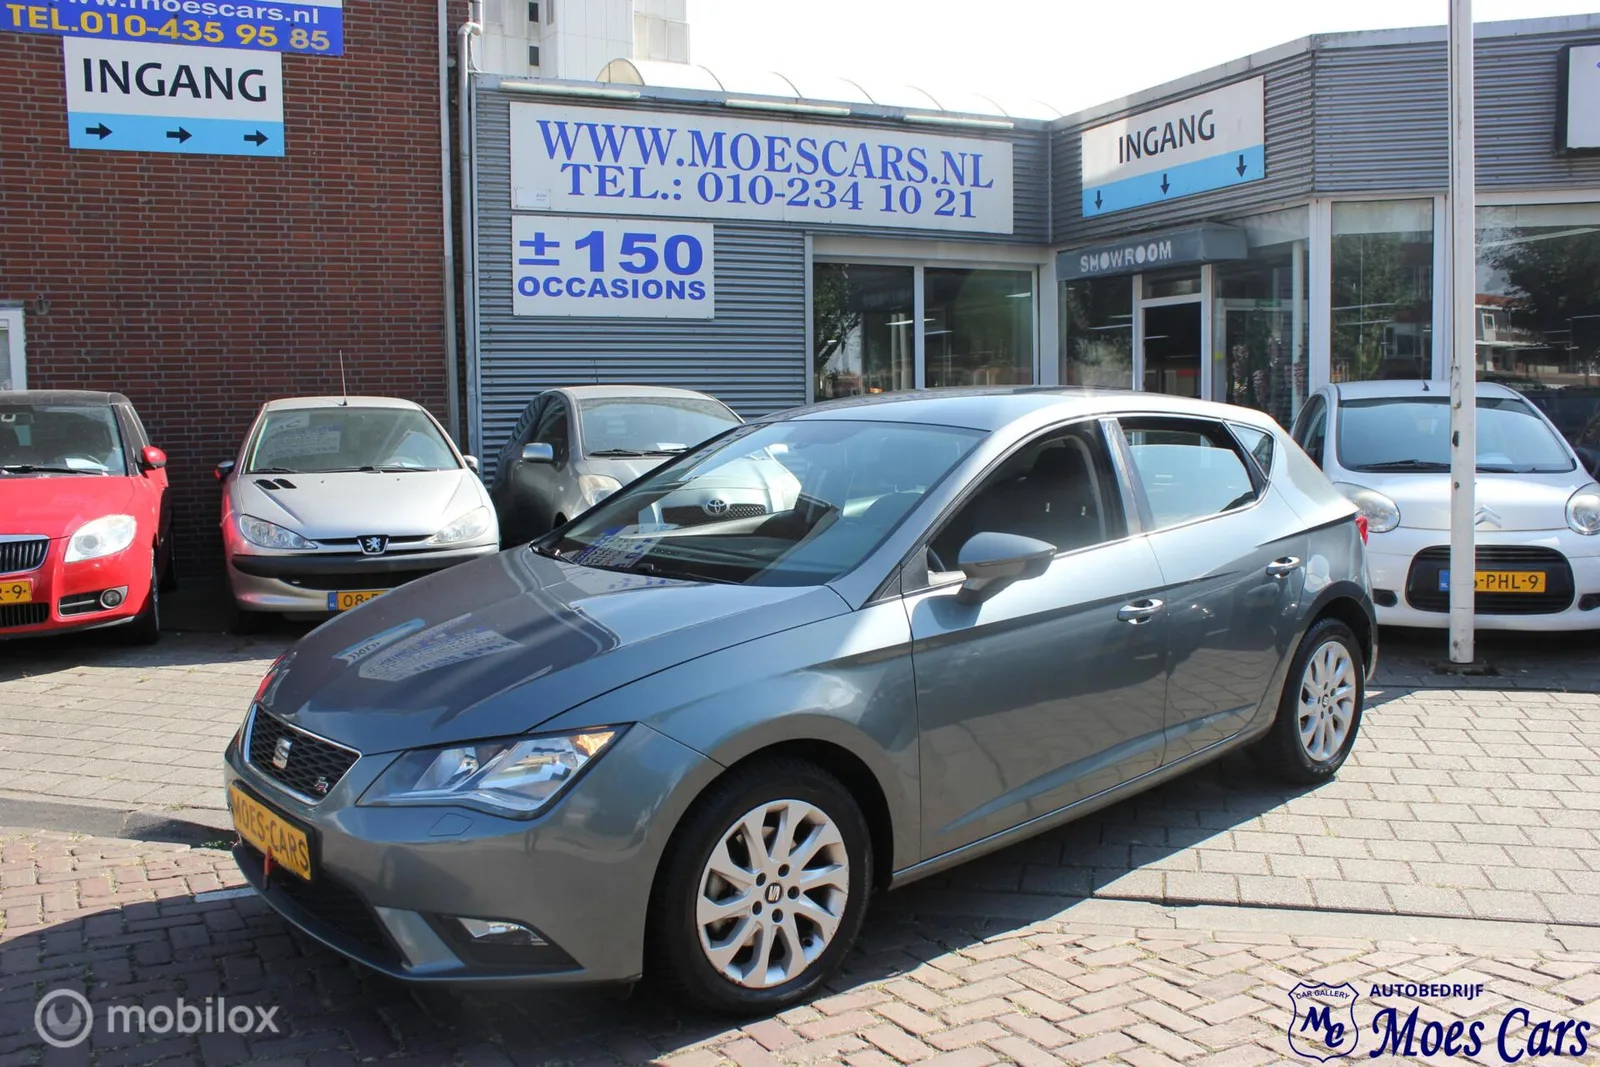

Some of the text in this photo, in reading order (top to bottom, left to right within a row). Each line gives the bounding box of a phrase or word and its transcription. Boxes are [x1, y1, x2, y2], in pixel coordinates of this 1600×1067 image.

[52, 0, 318, 24] .moescars.nl
[236, 24, 278, 47] 95
[289, 28, 330, 50] 85
[83, 57, 267, 102] INGANG
[536, 120, 994, 189] WWW.MOESCARS.NL
[1118, 108, 1216, 164] INGANG
[561, 162, 977, 219] TEL.: 010-234 10 21
[1080, 240, 1172, 273] SHOWROOM
[517, 275, 707, 301] OCCASIONS
[1474, 574, 1539, 589] -PHL-9
[231, 794, 309, 872] MOES-CARS
